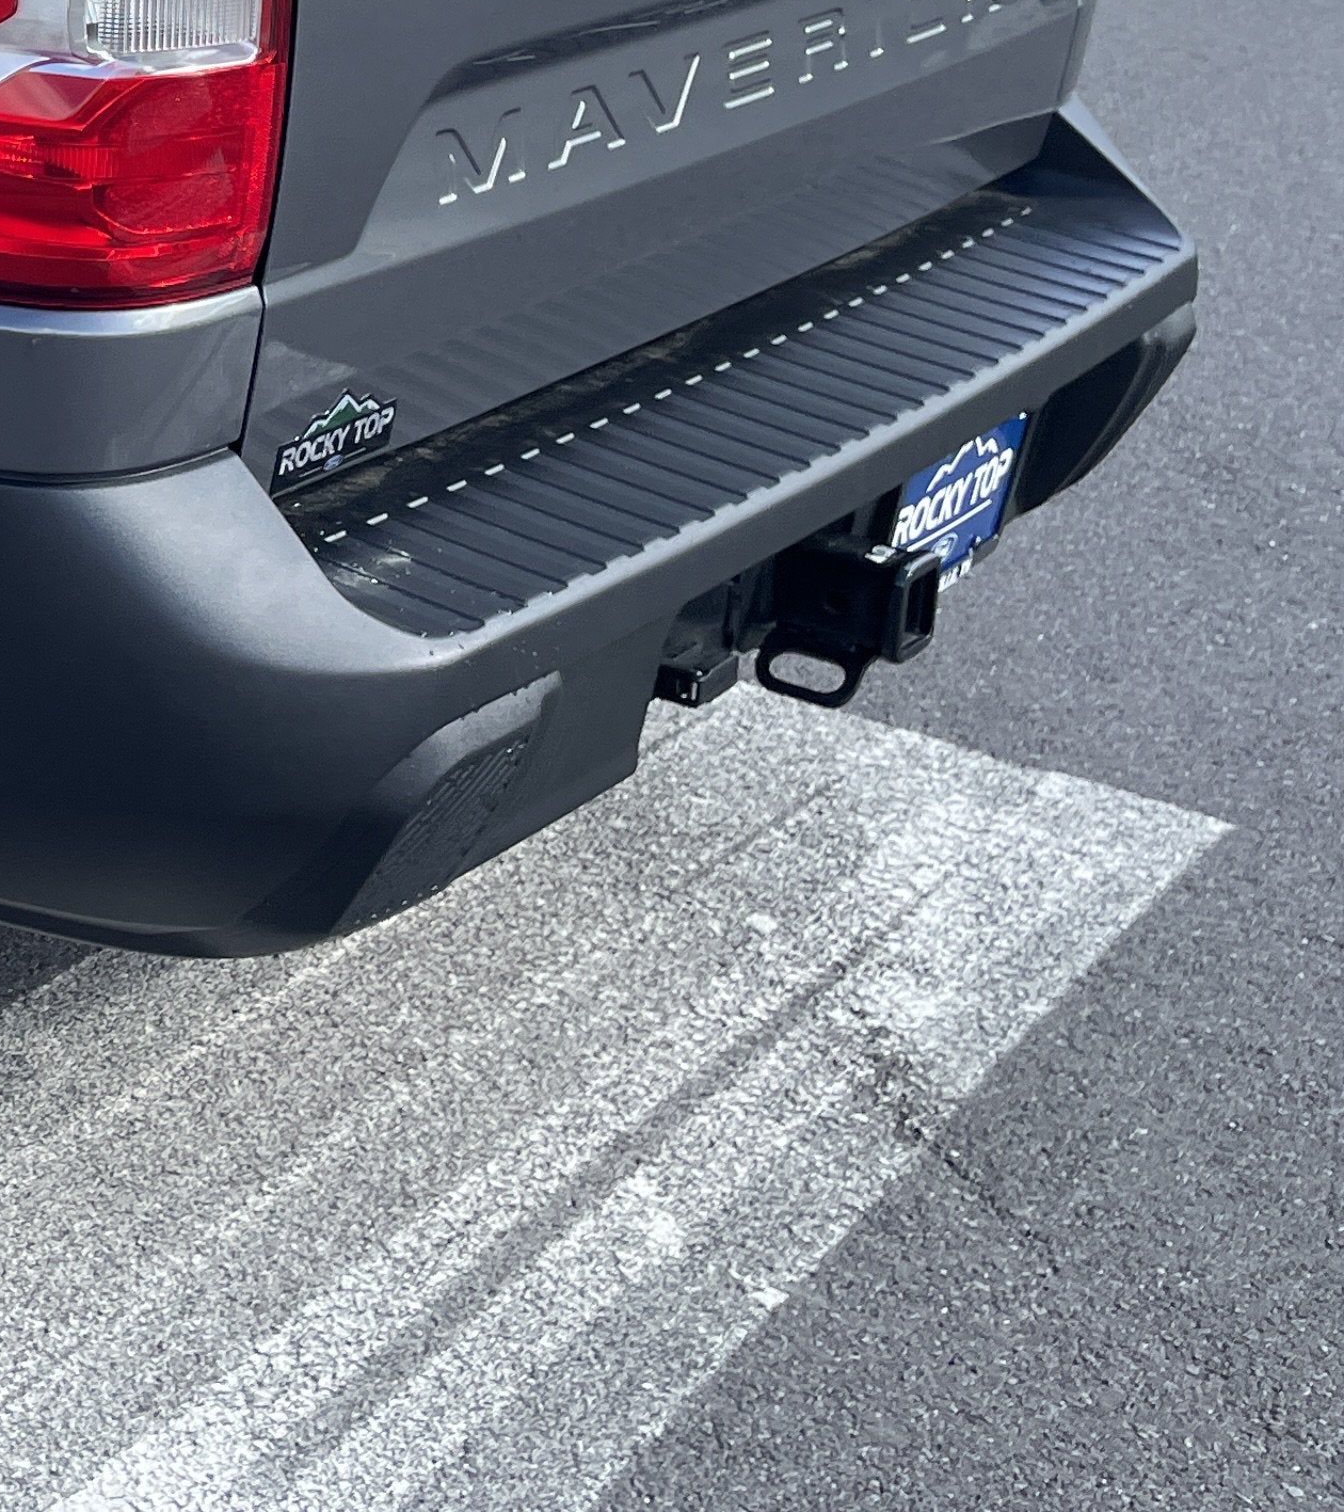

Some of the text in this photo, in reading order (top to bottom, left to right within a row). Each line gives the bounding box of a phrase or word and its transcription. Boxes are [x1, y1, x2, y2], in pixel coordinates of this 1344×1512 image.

[278, 406, 394, 475] ROCKY TOP
[891, 472, 973, 548] ROCKY
[970, 448, 1013, 506] TOP
